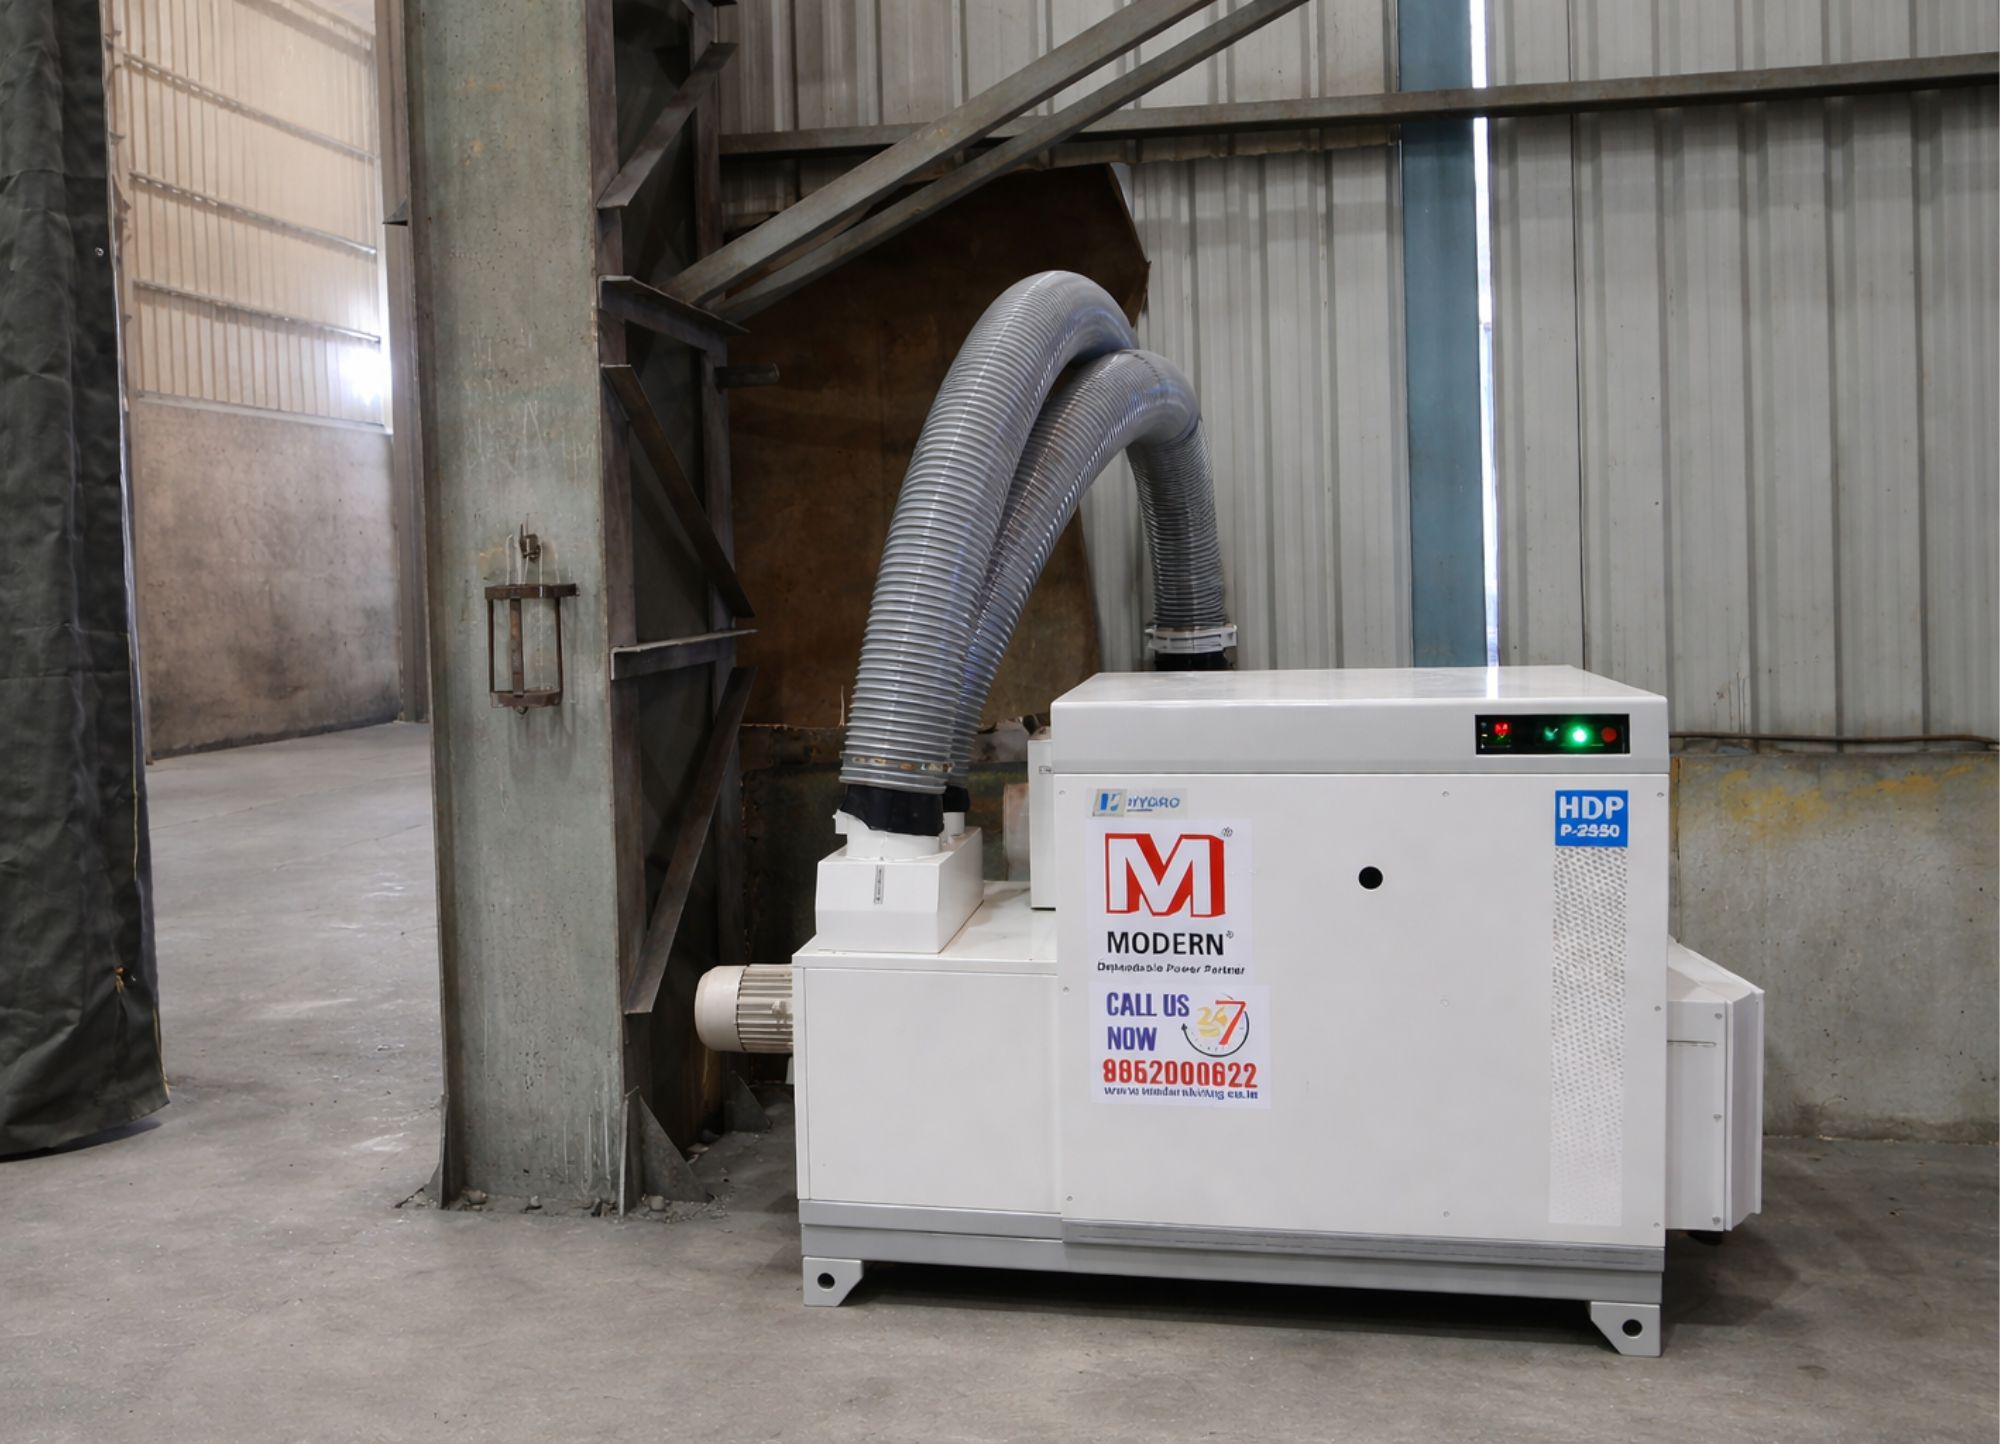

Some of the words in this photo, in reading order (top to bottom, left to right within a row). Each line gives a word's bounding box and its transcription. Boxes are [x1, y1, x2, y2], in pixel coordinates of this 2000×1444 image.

[1559, 795, 1625, 820] HDP
[1104, 833, 1226, 918] M
[1107, 930, 1224, 955] MODERN
[1106, 992, 1157, 1017] CALL
[1163, 994, 1190, 1017] US
[1107, 1026, 1157, 1051] NOW
